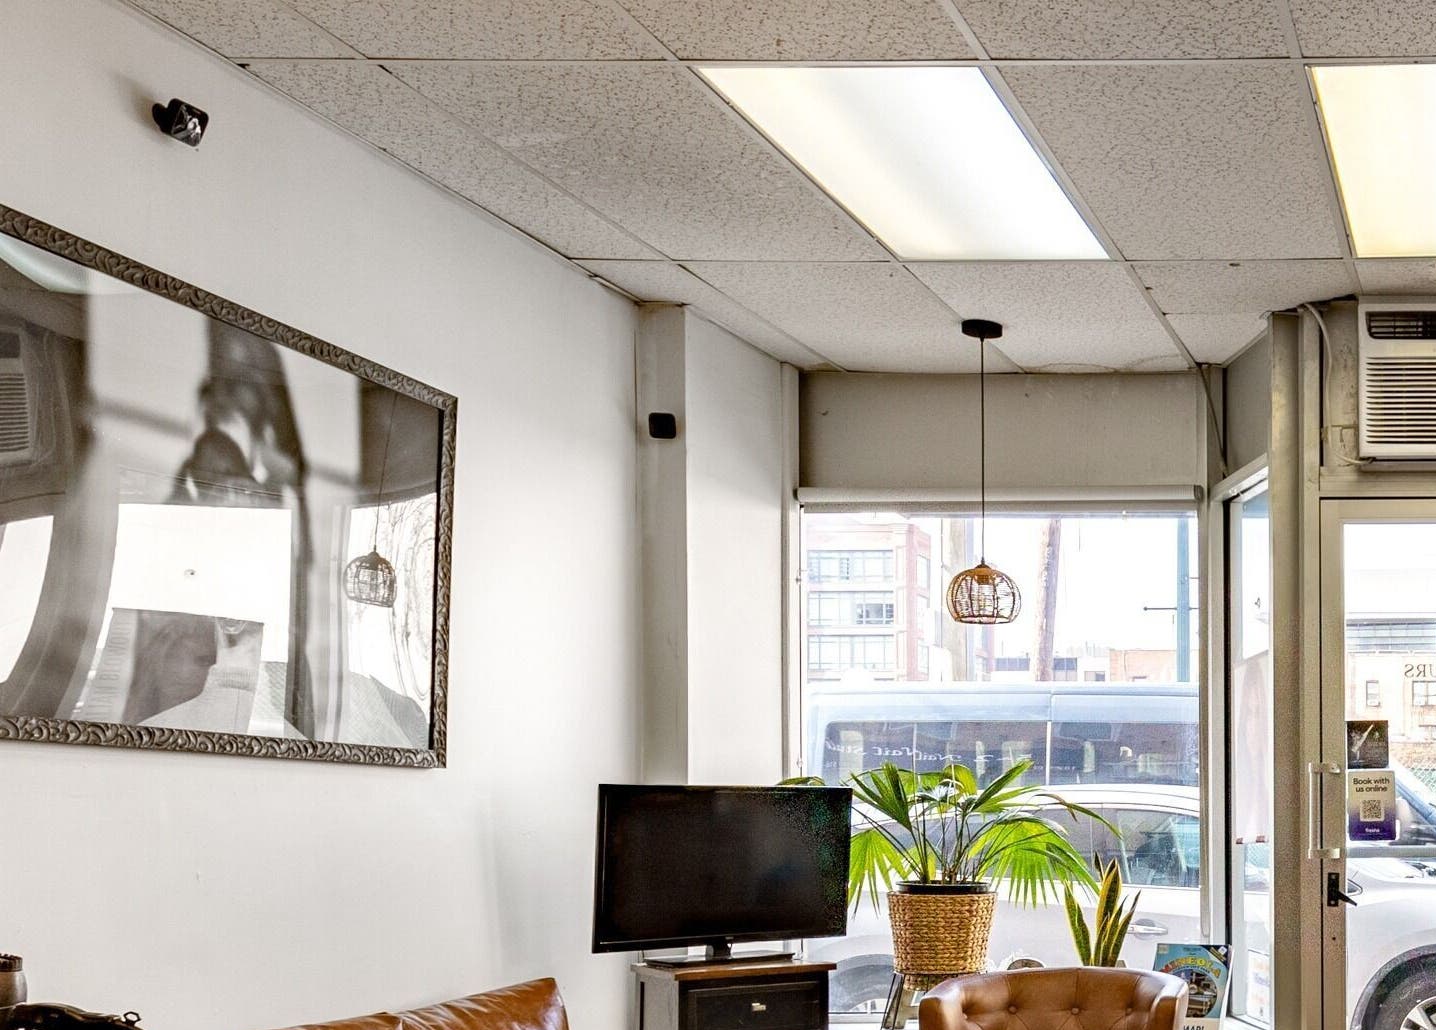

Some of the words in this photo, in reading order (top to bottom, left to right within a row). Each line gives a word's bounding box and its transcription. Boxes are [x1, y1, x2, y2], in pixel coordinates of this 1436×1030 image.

[1353, 777, 1373, 785] Book
[1373, 777, 1390, 785] with
[1365, 785, 1388, 793] online
